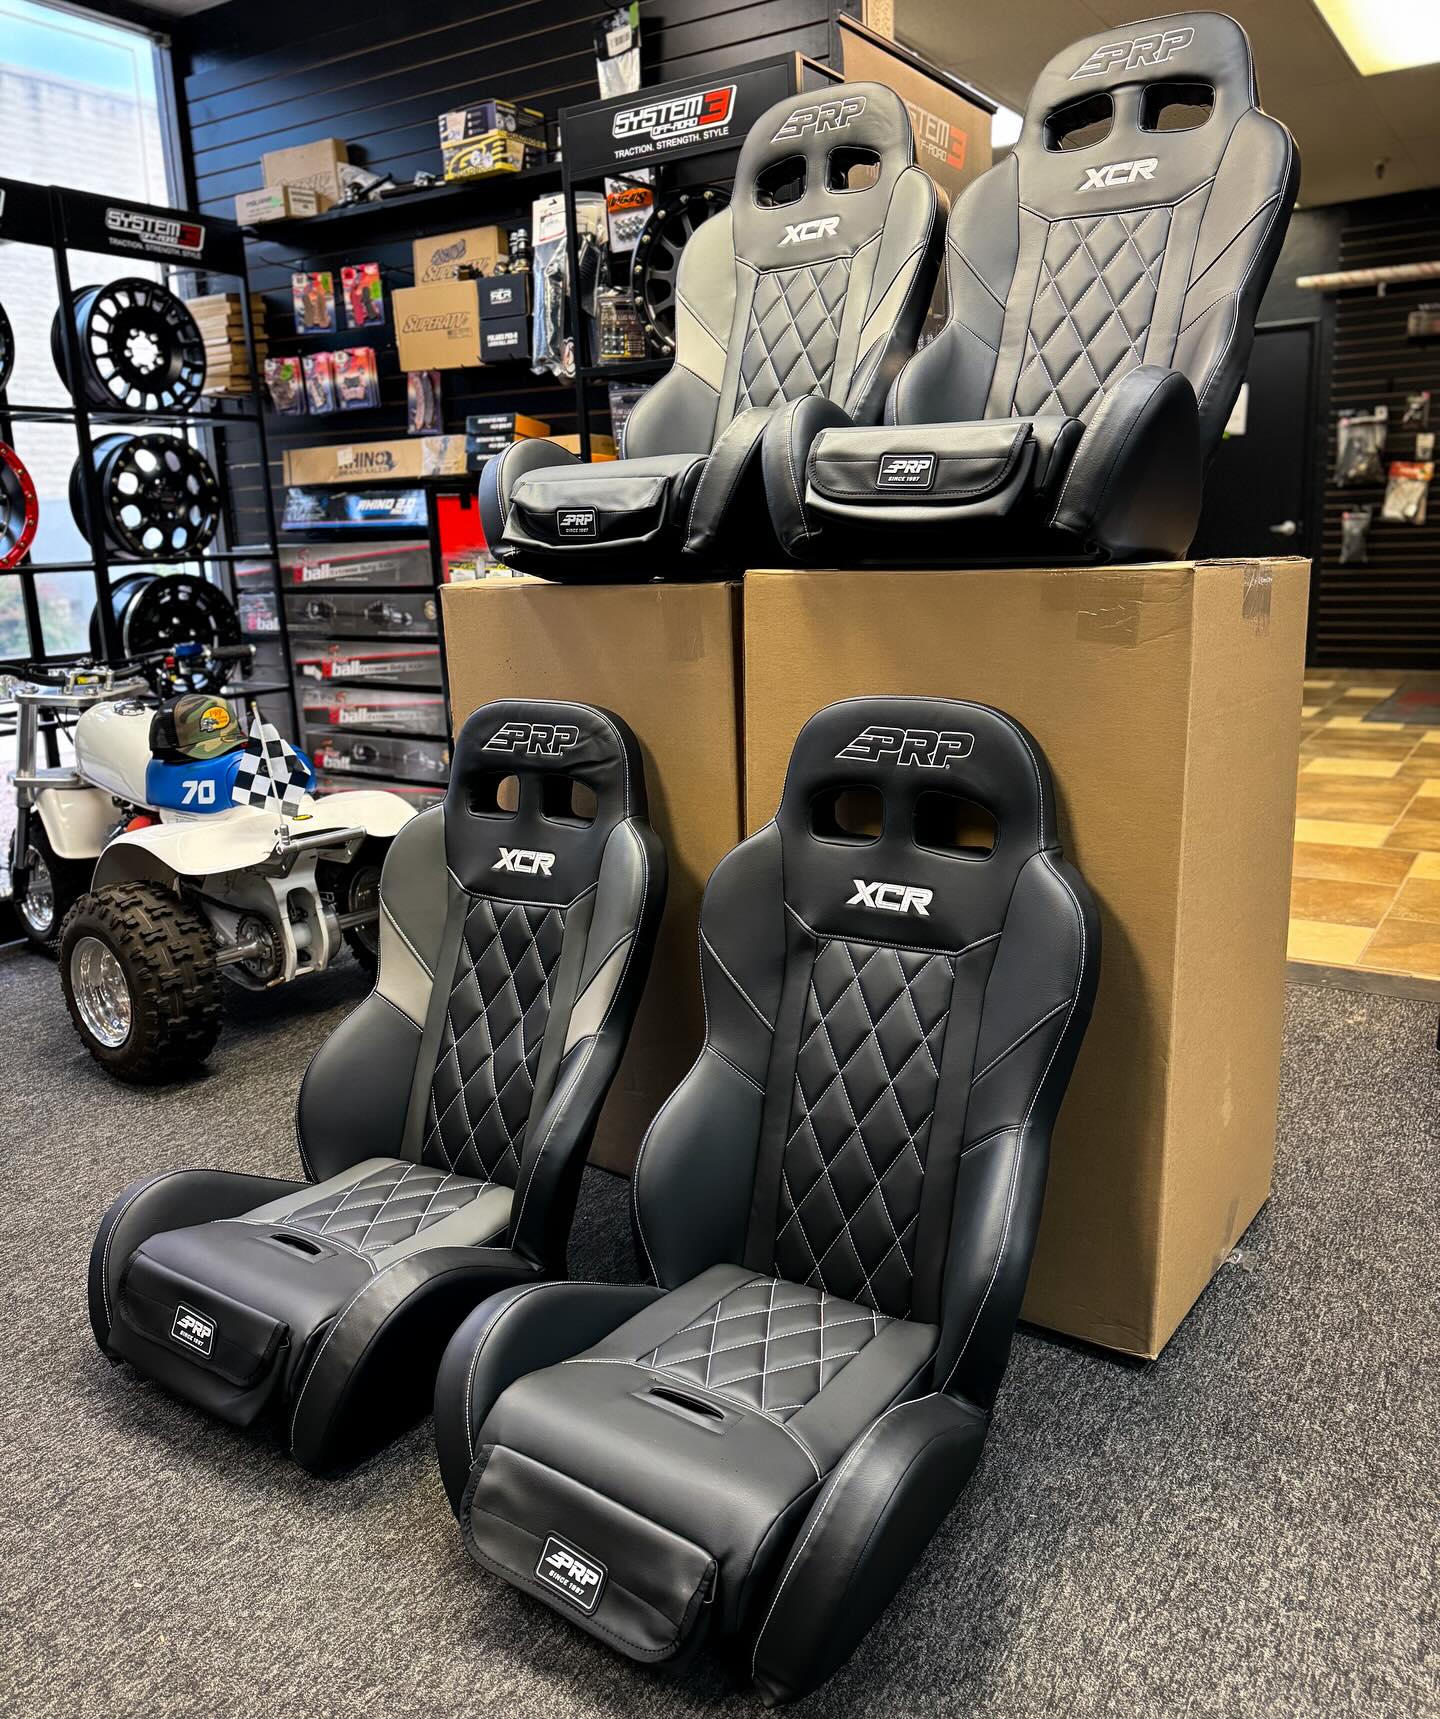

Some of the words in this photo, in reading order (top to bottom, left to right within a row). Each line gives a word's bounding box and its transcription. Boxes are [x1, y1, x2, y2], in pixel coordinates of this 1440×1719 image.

[1068, 28, 1195, 80] PRP
[614, 95, 704, 134] SYSTEM
[699, 88, 731, 125] 3
[652, 117, 699, 134] OFF-ROAD
[770, 96, 867, 143] PRP
[703, 126, 730, 140] STYLE
[1076, 157, 1159, 191] XCR
[107, 210, 181, 237] SYSTEM
[777, 216, 841, 247] XCR
[883, 460, 931, 474] PRP
[560, 514, 592, 526] PRP
[482, 722, 579, 755] PRP
[834, 725, 975, 768] PRP
[181, 779, 215, 804] 70
[491, 847, 556, 876] XCR
[846, 879, 934, 916] XCR
[177, 1315, 212, 1339] PRP
[545, 1551, 600, 1586] PRP
[548, 1569, 570, 1587] SINCE
